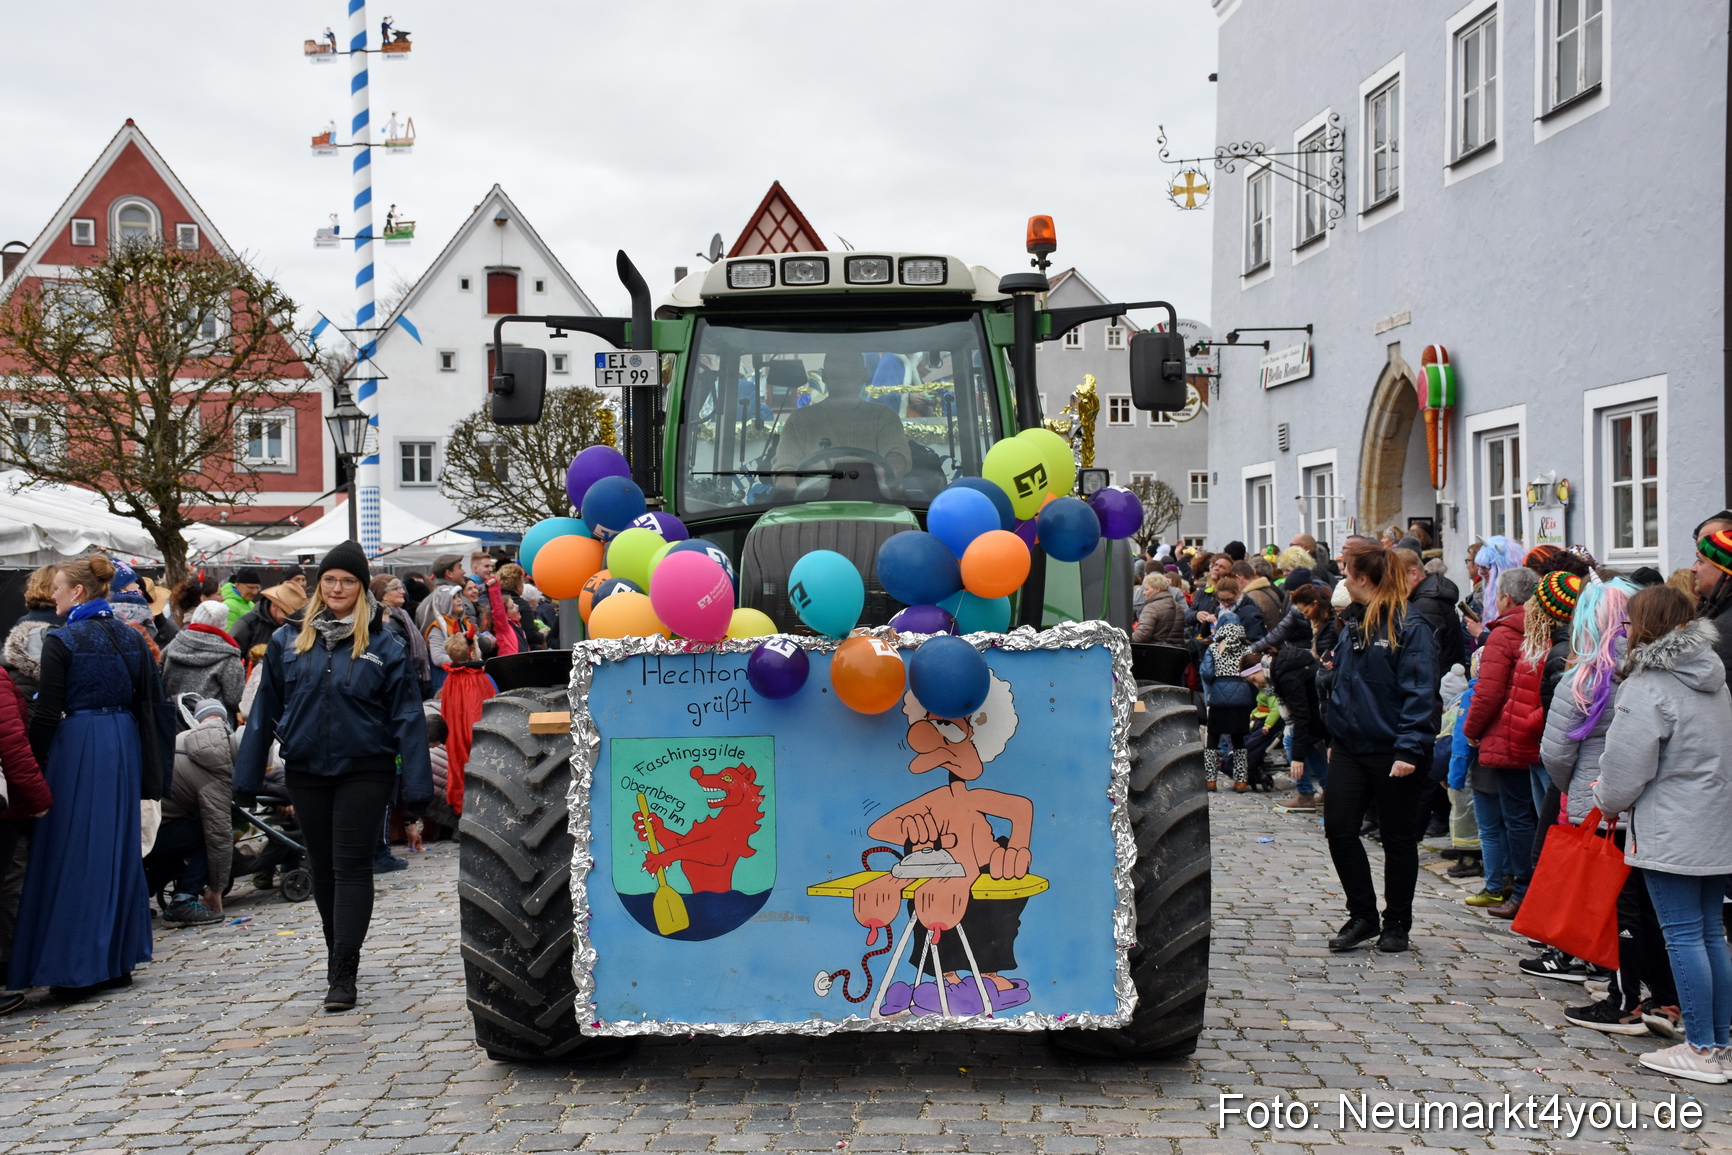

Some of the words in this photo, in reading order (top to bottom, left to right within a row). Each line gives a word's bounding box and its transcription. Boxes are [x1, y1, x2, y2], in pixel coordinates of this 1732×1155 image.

[608, 354, 627, 369] EI
[1268, 366, 1283, 383] Bella
[1283, 362, 1301, 379] Roma
[604, 369, 624, 384] FT
[630, 369, 649, 384] 99
[1545, 516, 1557, 530] Eis
[687, 687, 752, 727] grüßt
[633, 744, 746, 777] Faschingsgilde
[620, 775, 687, 813] Obernberg
[650, 801, 668, 816] am
[668, 809, 686, 827] Inn
